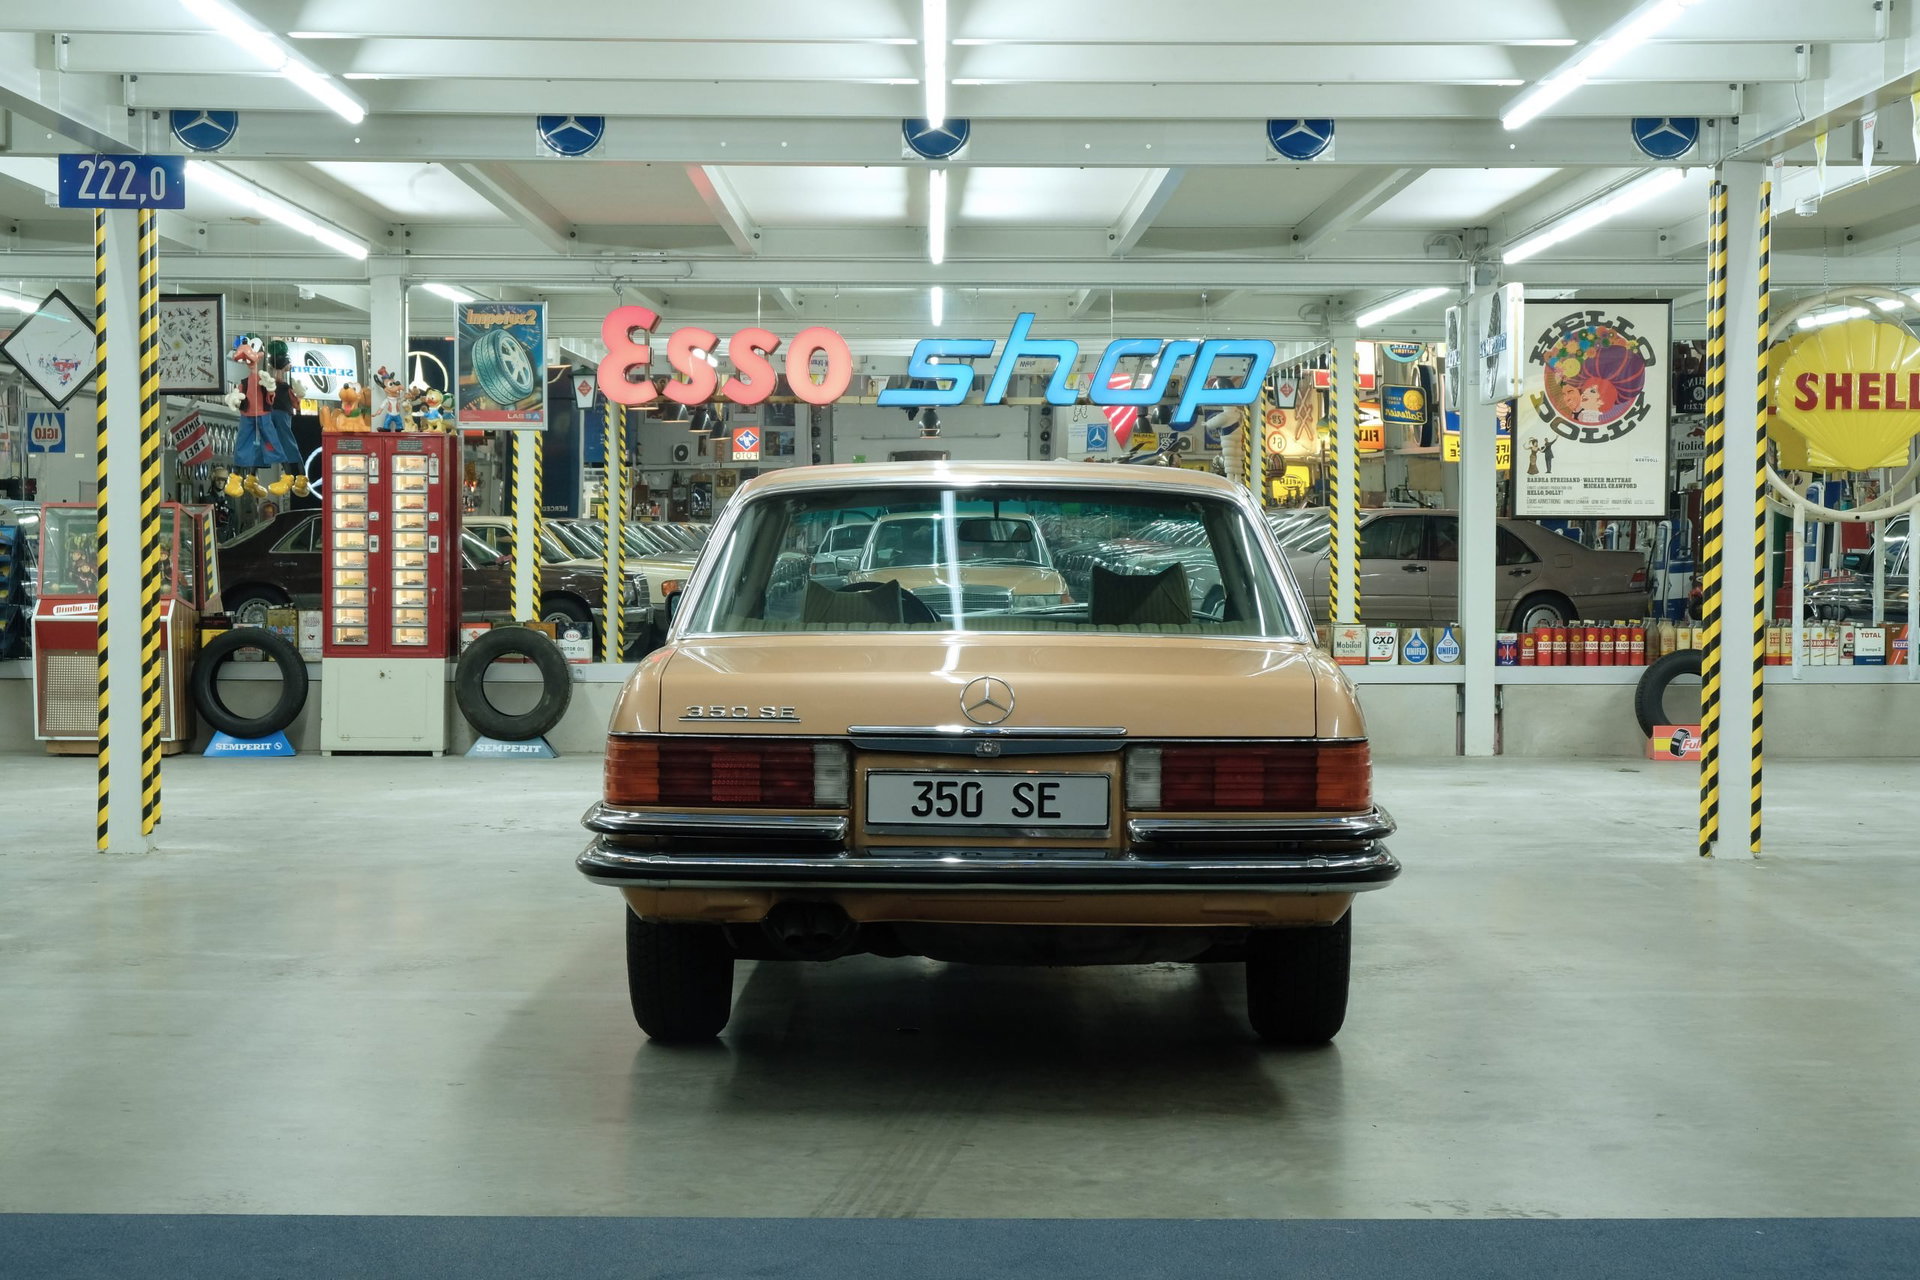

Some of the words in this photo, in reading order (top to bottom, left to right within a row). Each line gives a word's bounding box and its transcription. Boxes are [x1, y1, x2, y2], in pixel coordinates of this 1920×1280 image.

[78, 161, 165, 204] 222,0
[1529, 310, 1656, 367] HELLO
[877, 312, 1276, 431] shop
[1794, 372, 1920, 410] SHELL
[1530, 391, 1652, 444] DOLLY
[1336, 641, 1362, 649] Mobiloil
[1372, 636, 1394, 645] CXD
[686, 705, 750, 718] 350
[758, 706, 797, 718] SE
[215, 742, 272, 751] SEMPERIT
[476, 743, 542, 753] SEMPERIT
[911, 780, 984, 818] 350
[1011, 781, 1061, 819] SE
